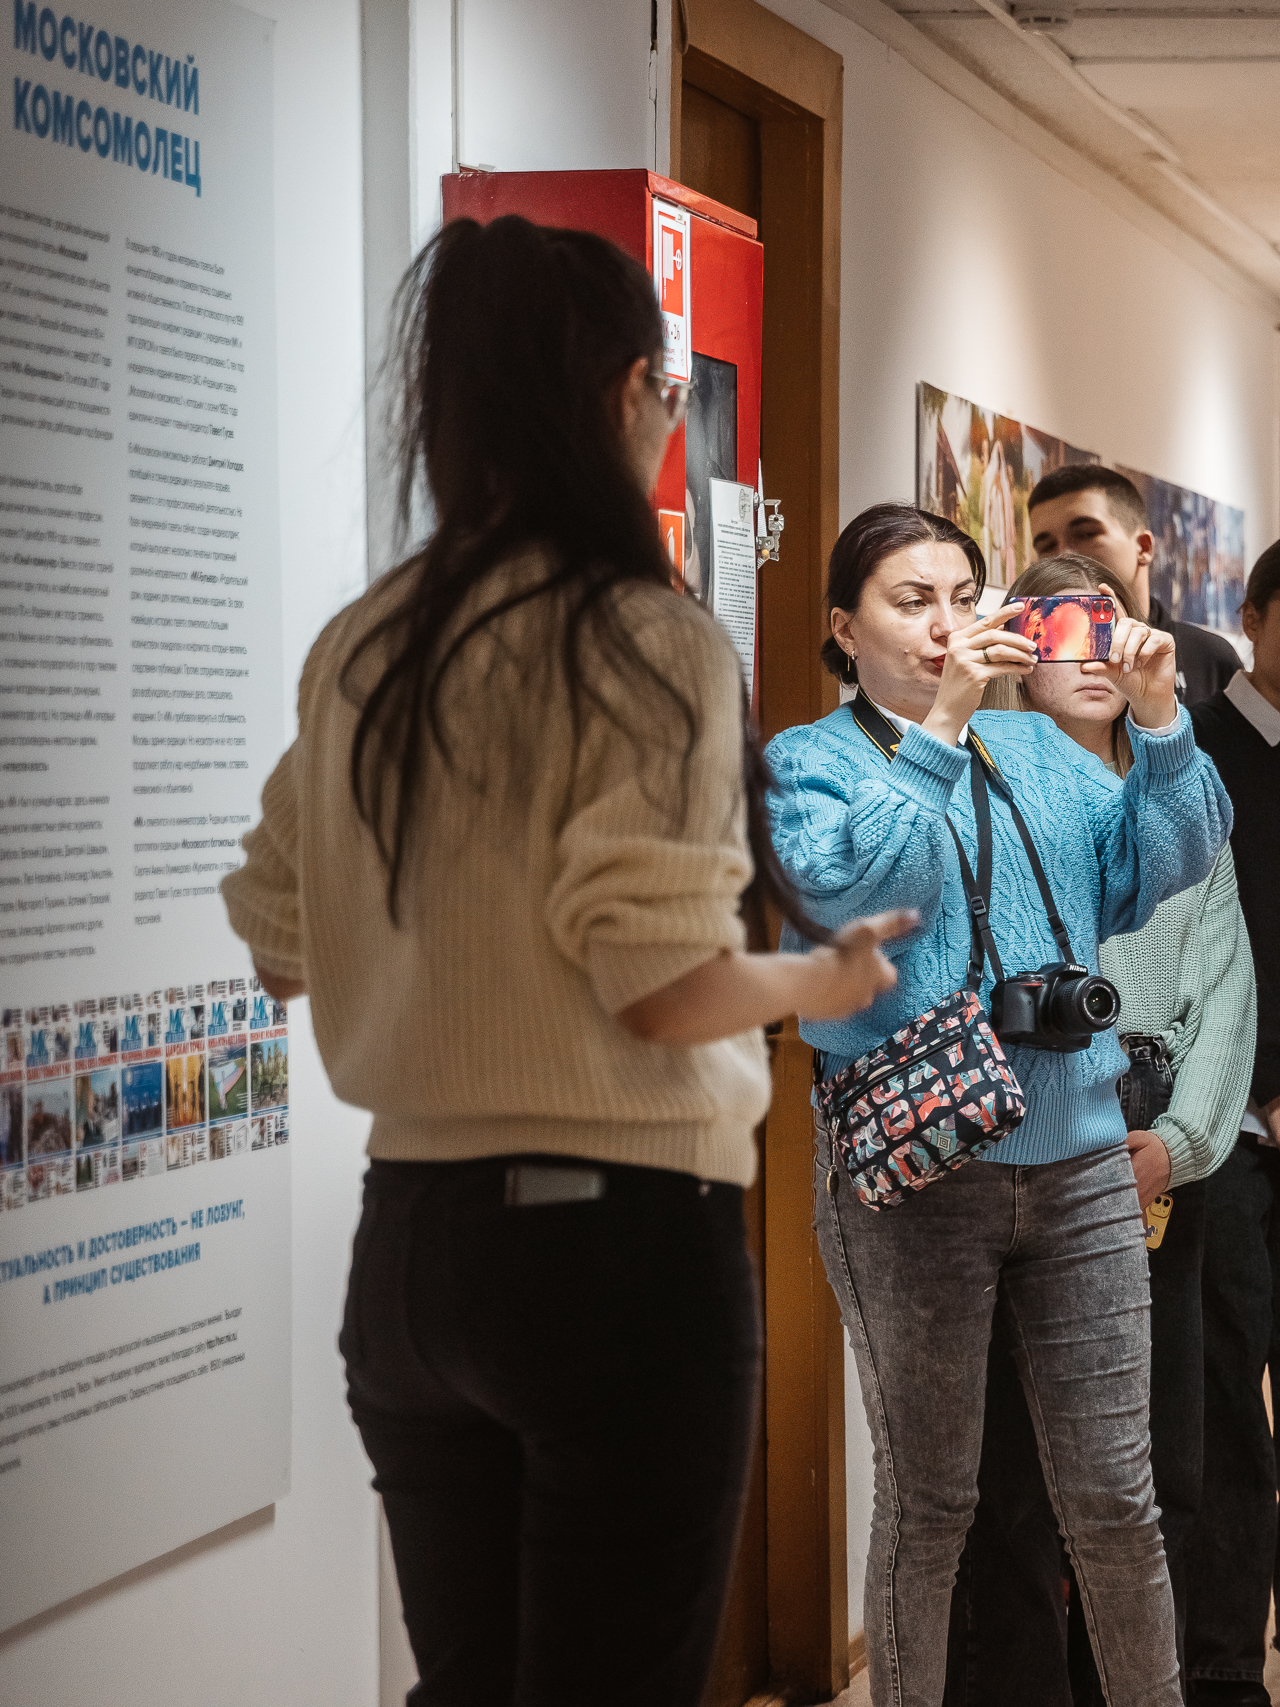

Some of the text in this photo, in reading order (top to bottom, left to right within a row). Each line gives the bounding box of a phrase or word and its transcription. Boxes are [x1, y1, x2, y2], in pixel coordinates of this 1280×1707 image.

[14, 0, 199, 116] МОСКОВСКИЙ
[14, 76, 202, 198] КОМСОМОЛЕЦ
[1069, 965, 1087, 973] Nikon
[0, 1244, 74, 1281] ТУАЛЬНОСТЬ
[77, 1241, 86, 1260] И
[88, 1217, 178, 1262] ДОСТОВЕРНОСТЬ
[191, 1209, 204, 1230] НЕ
[206, 1199, 246, 1226] ЛОЗУНГ,
[42, 1241, 201, 1305] А ПРИНЦИП СУЩЕСТВОВАНИЯ
